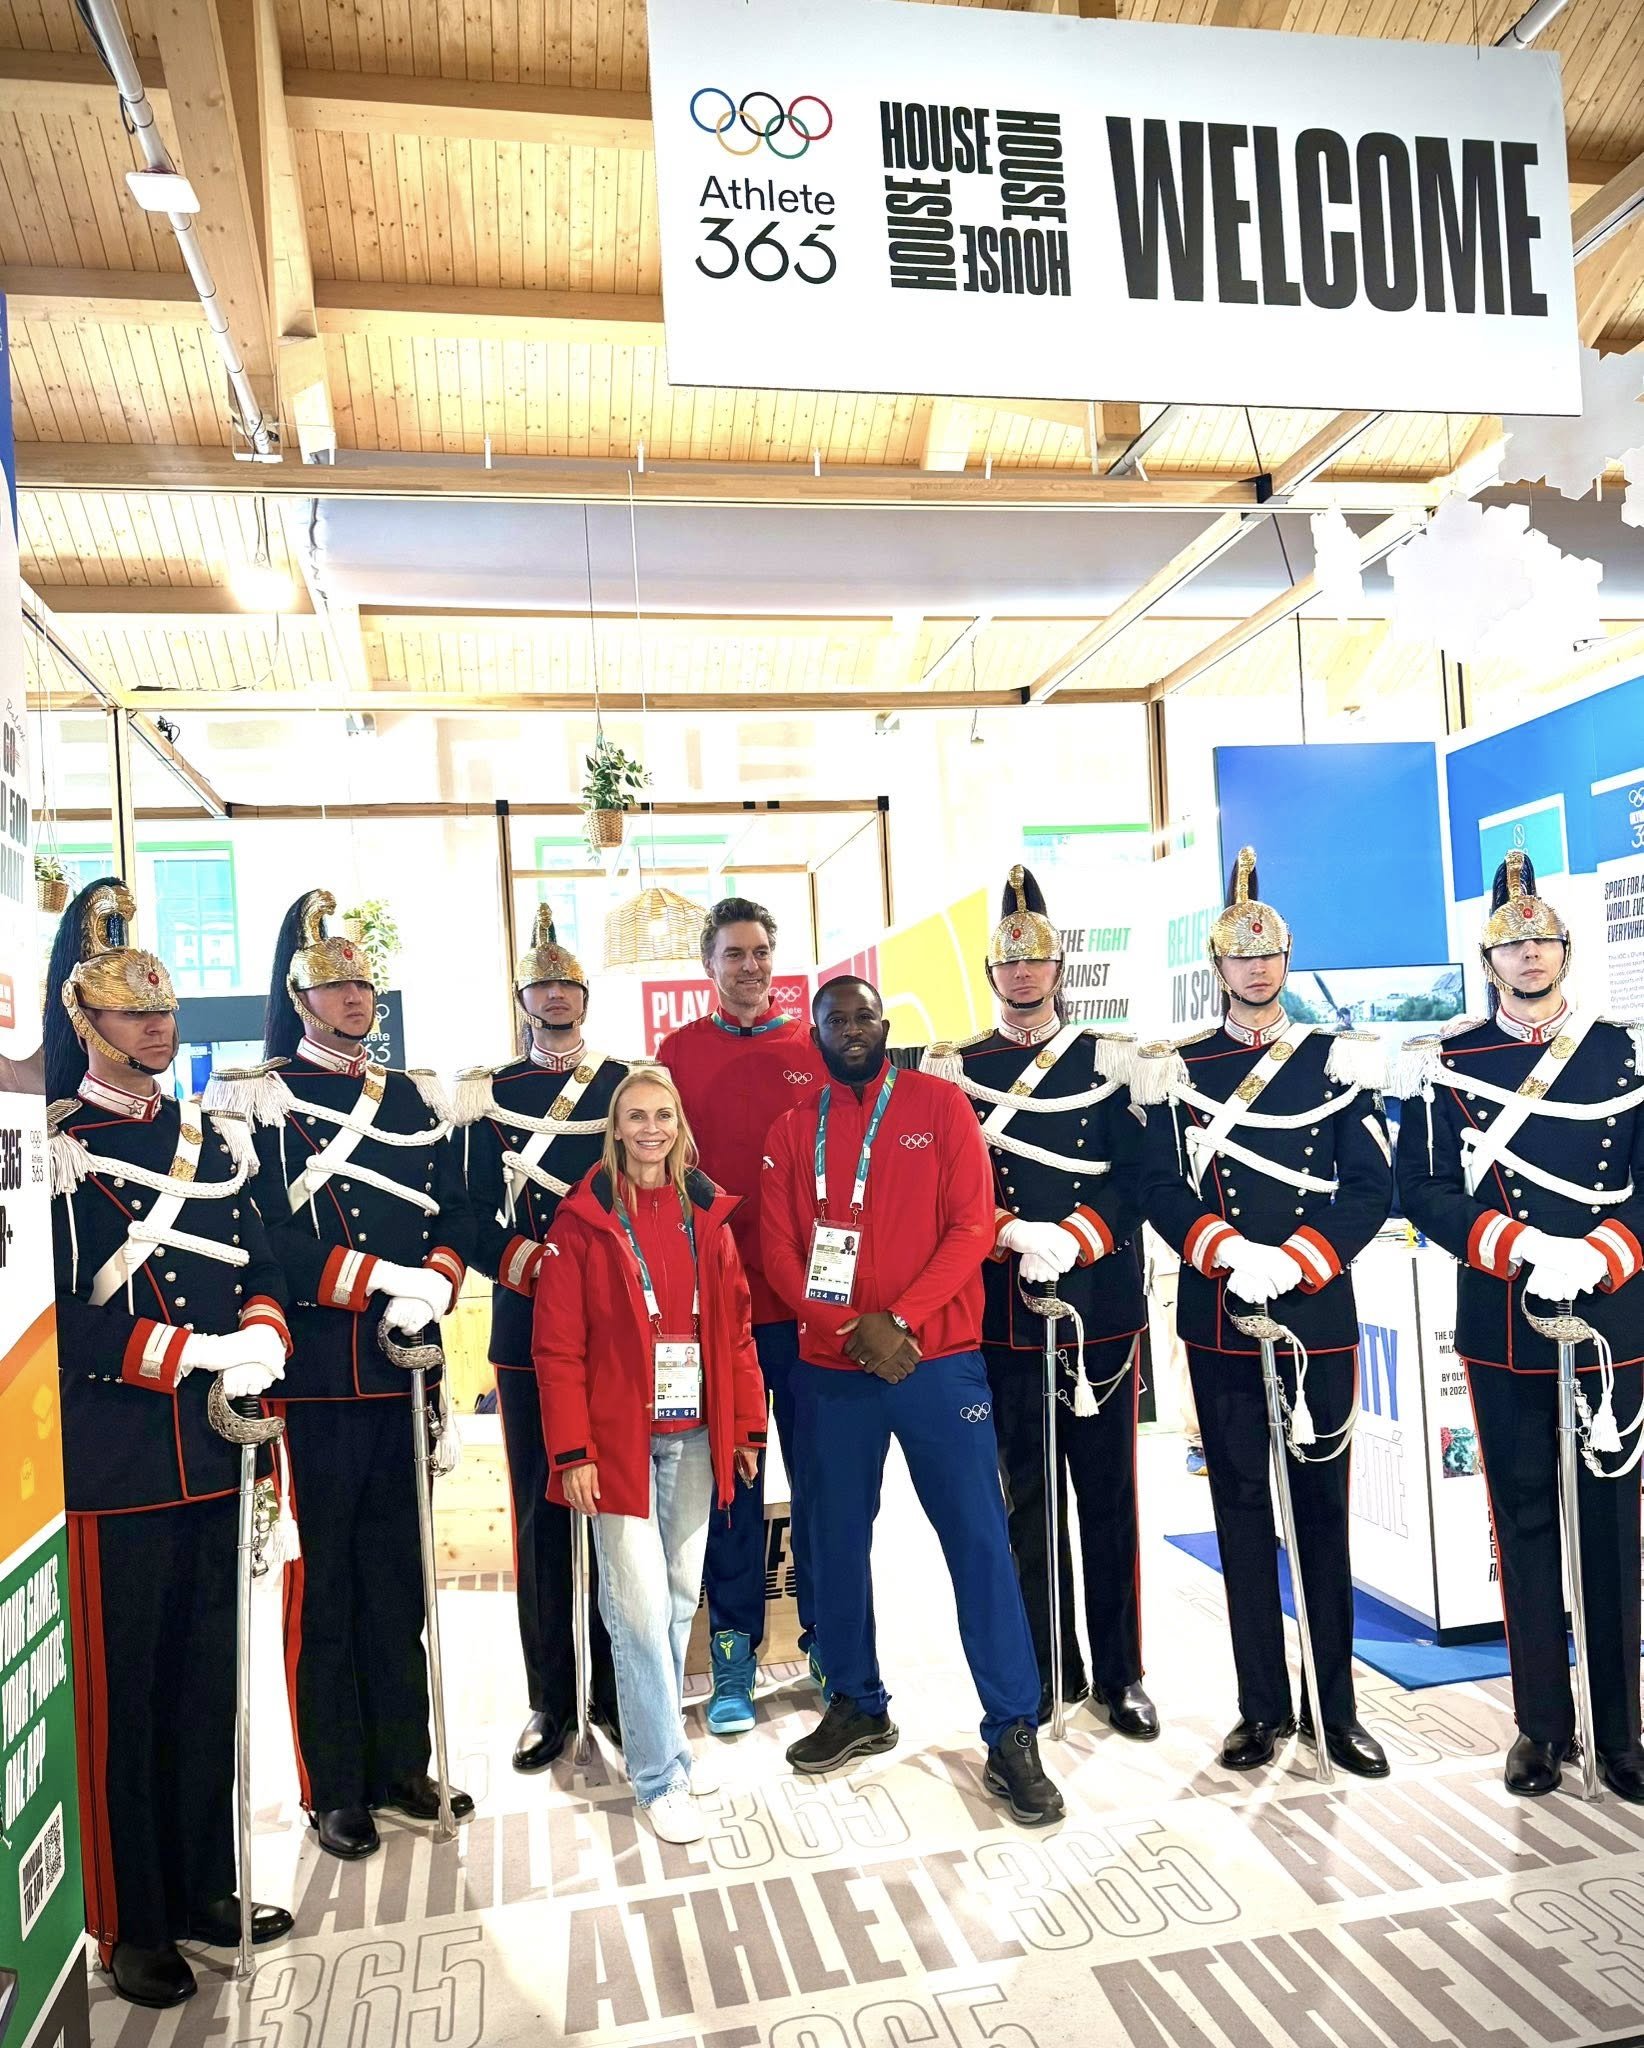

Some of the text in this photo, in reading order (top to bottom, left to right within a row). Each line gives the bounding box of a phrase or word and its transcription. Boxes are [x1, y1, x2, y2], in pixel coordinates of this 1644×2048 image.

[880, 101, 993, 174] HOUSE
[996, 109, 1067, 223] HOUSE
[699, 175, 835, 215] Athlete
[1106, 115, 1548, 317] WELCOME
[695, 217, 837, 285] 365
[884, 175, 957, 290] HOUSE
[960, 225, 1072, 296] HOUSE
[4, 722, 16, 777] GO
[9, 789, 28, 848] 500
[1604, 878, 1626, 901] SPORT
[1627, 875, 1640, 896] FOR
[1059, 928, 1132, 953] THE FIGHT
[1608, 919, 1644, 944] EVERYWHE
[1064, 963, 1110, 988] AINST
[1173, 969, 1222, 1024] IN SPO
[652, 989, 711, 1029] PLAY
[1065, 998, 1129, 1021] PETITION
[365, 1043, 391, 1063] 65
[0, 1128, 22, 1191] 365
[810, 1290, 828, 1299] H24
[1434, 1331, 1448, 1341] THE
[1358, 1321, 1398, 1421] ITY
[1440, 1385, 1467, 1397] IN 2022
[1441, 1371, 1466, 1382] BY OLY
[658, 1409, 677, 1418] H24
[0, 1554, 61, 1672] YOUR GAMES,
[1, 1620, 67, 1751] YOUR PHOTOS,
[5, 1717, 46, 1831] ONE APP
